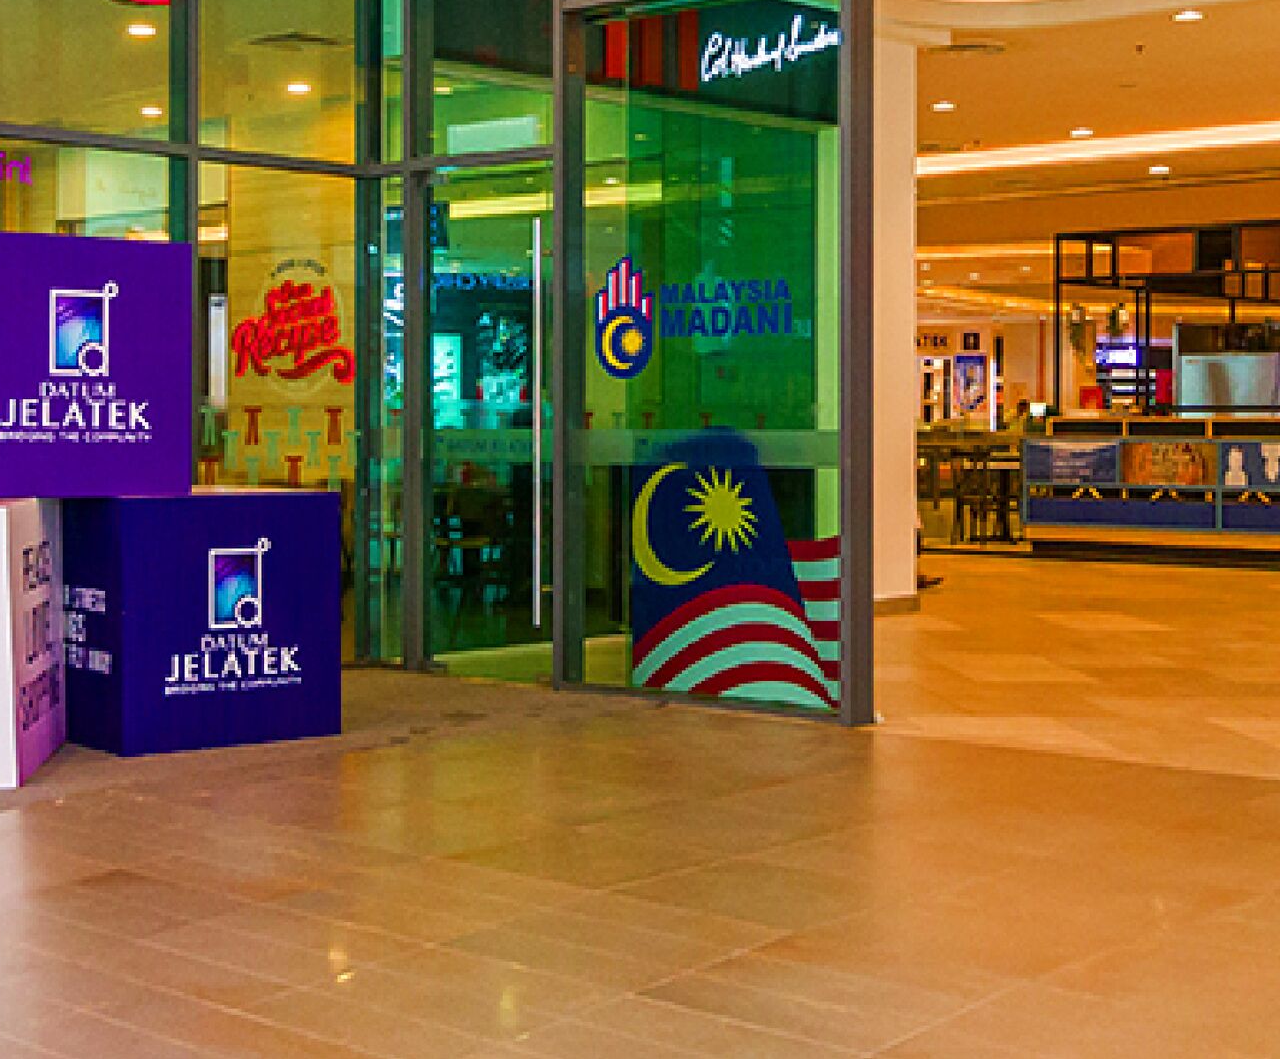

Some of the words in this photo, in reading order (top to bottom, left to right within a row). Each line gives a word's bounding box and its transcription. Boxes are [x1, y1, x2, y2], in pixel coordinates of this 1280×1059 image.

[660, 278, 792, 304] MALAYSIA
[660, 303, 793, 337] MADANI
[231, 315, 342, 378] Recipe
[39, 381, 116, 400] DATUM
[201, 633, 269, 652] DATUM
[165, 644, 302, 682] JELATEK
